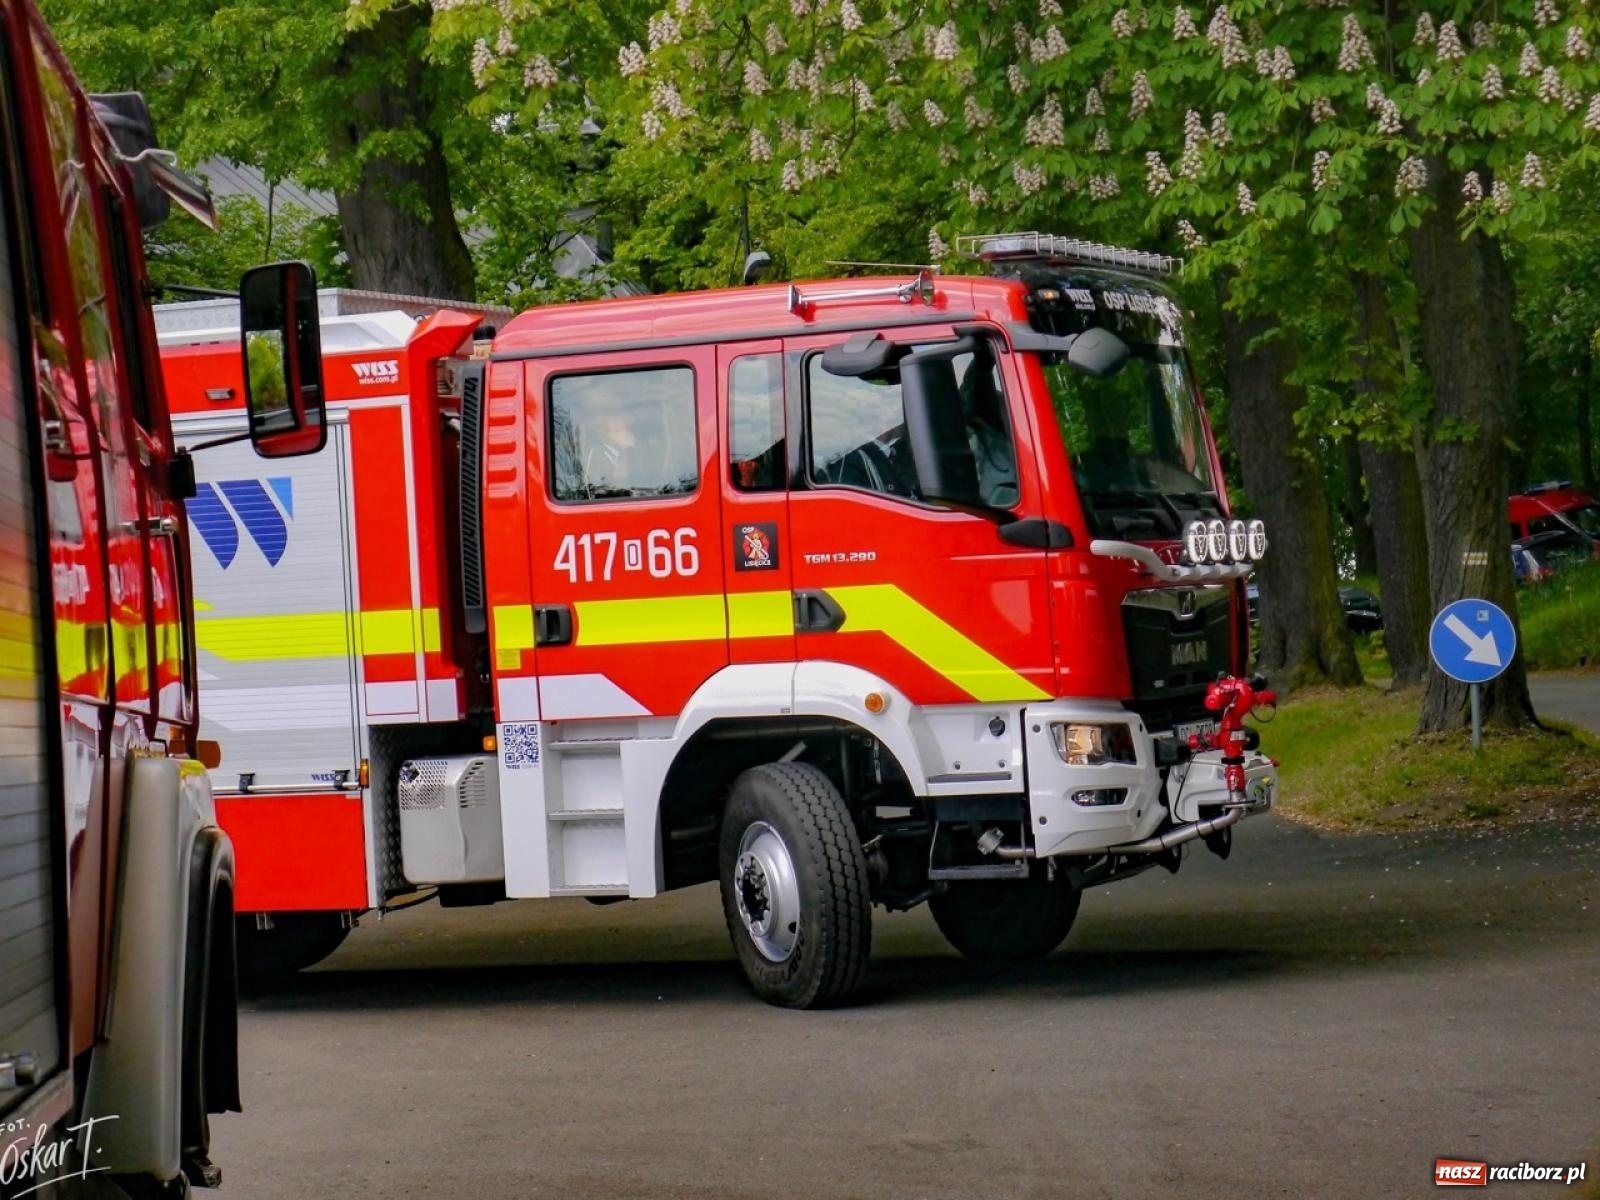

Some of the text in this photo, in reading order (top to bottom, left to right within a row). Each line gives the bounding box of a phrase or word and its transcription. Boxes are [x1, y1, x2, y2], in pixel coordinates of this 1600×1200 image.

[1103, 290, 1125, 310] OSP
[351, 360, 398, 377] WISS
[553, 532, 617, 583] 417
[647, 527, 699, 578] 66
[803, 551, 877, 565] TGM 13.290
[1170, 640, 1208, 666] MAN
